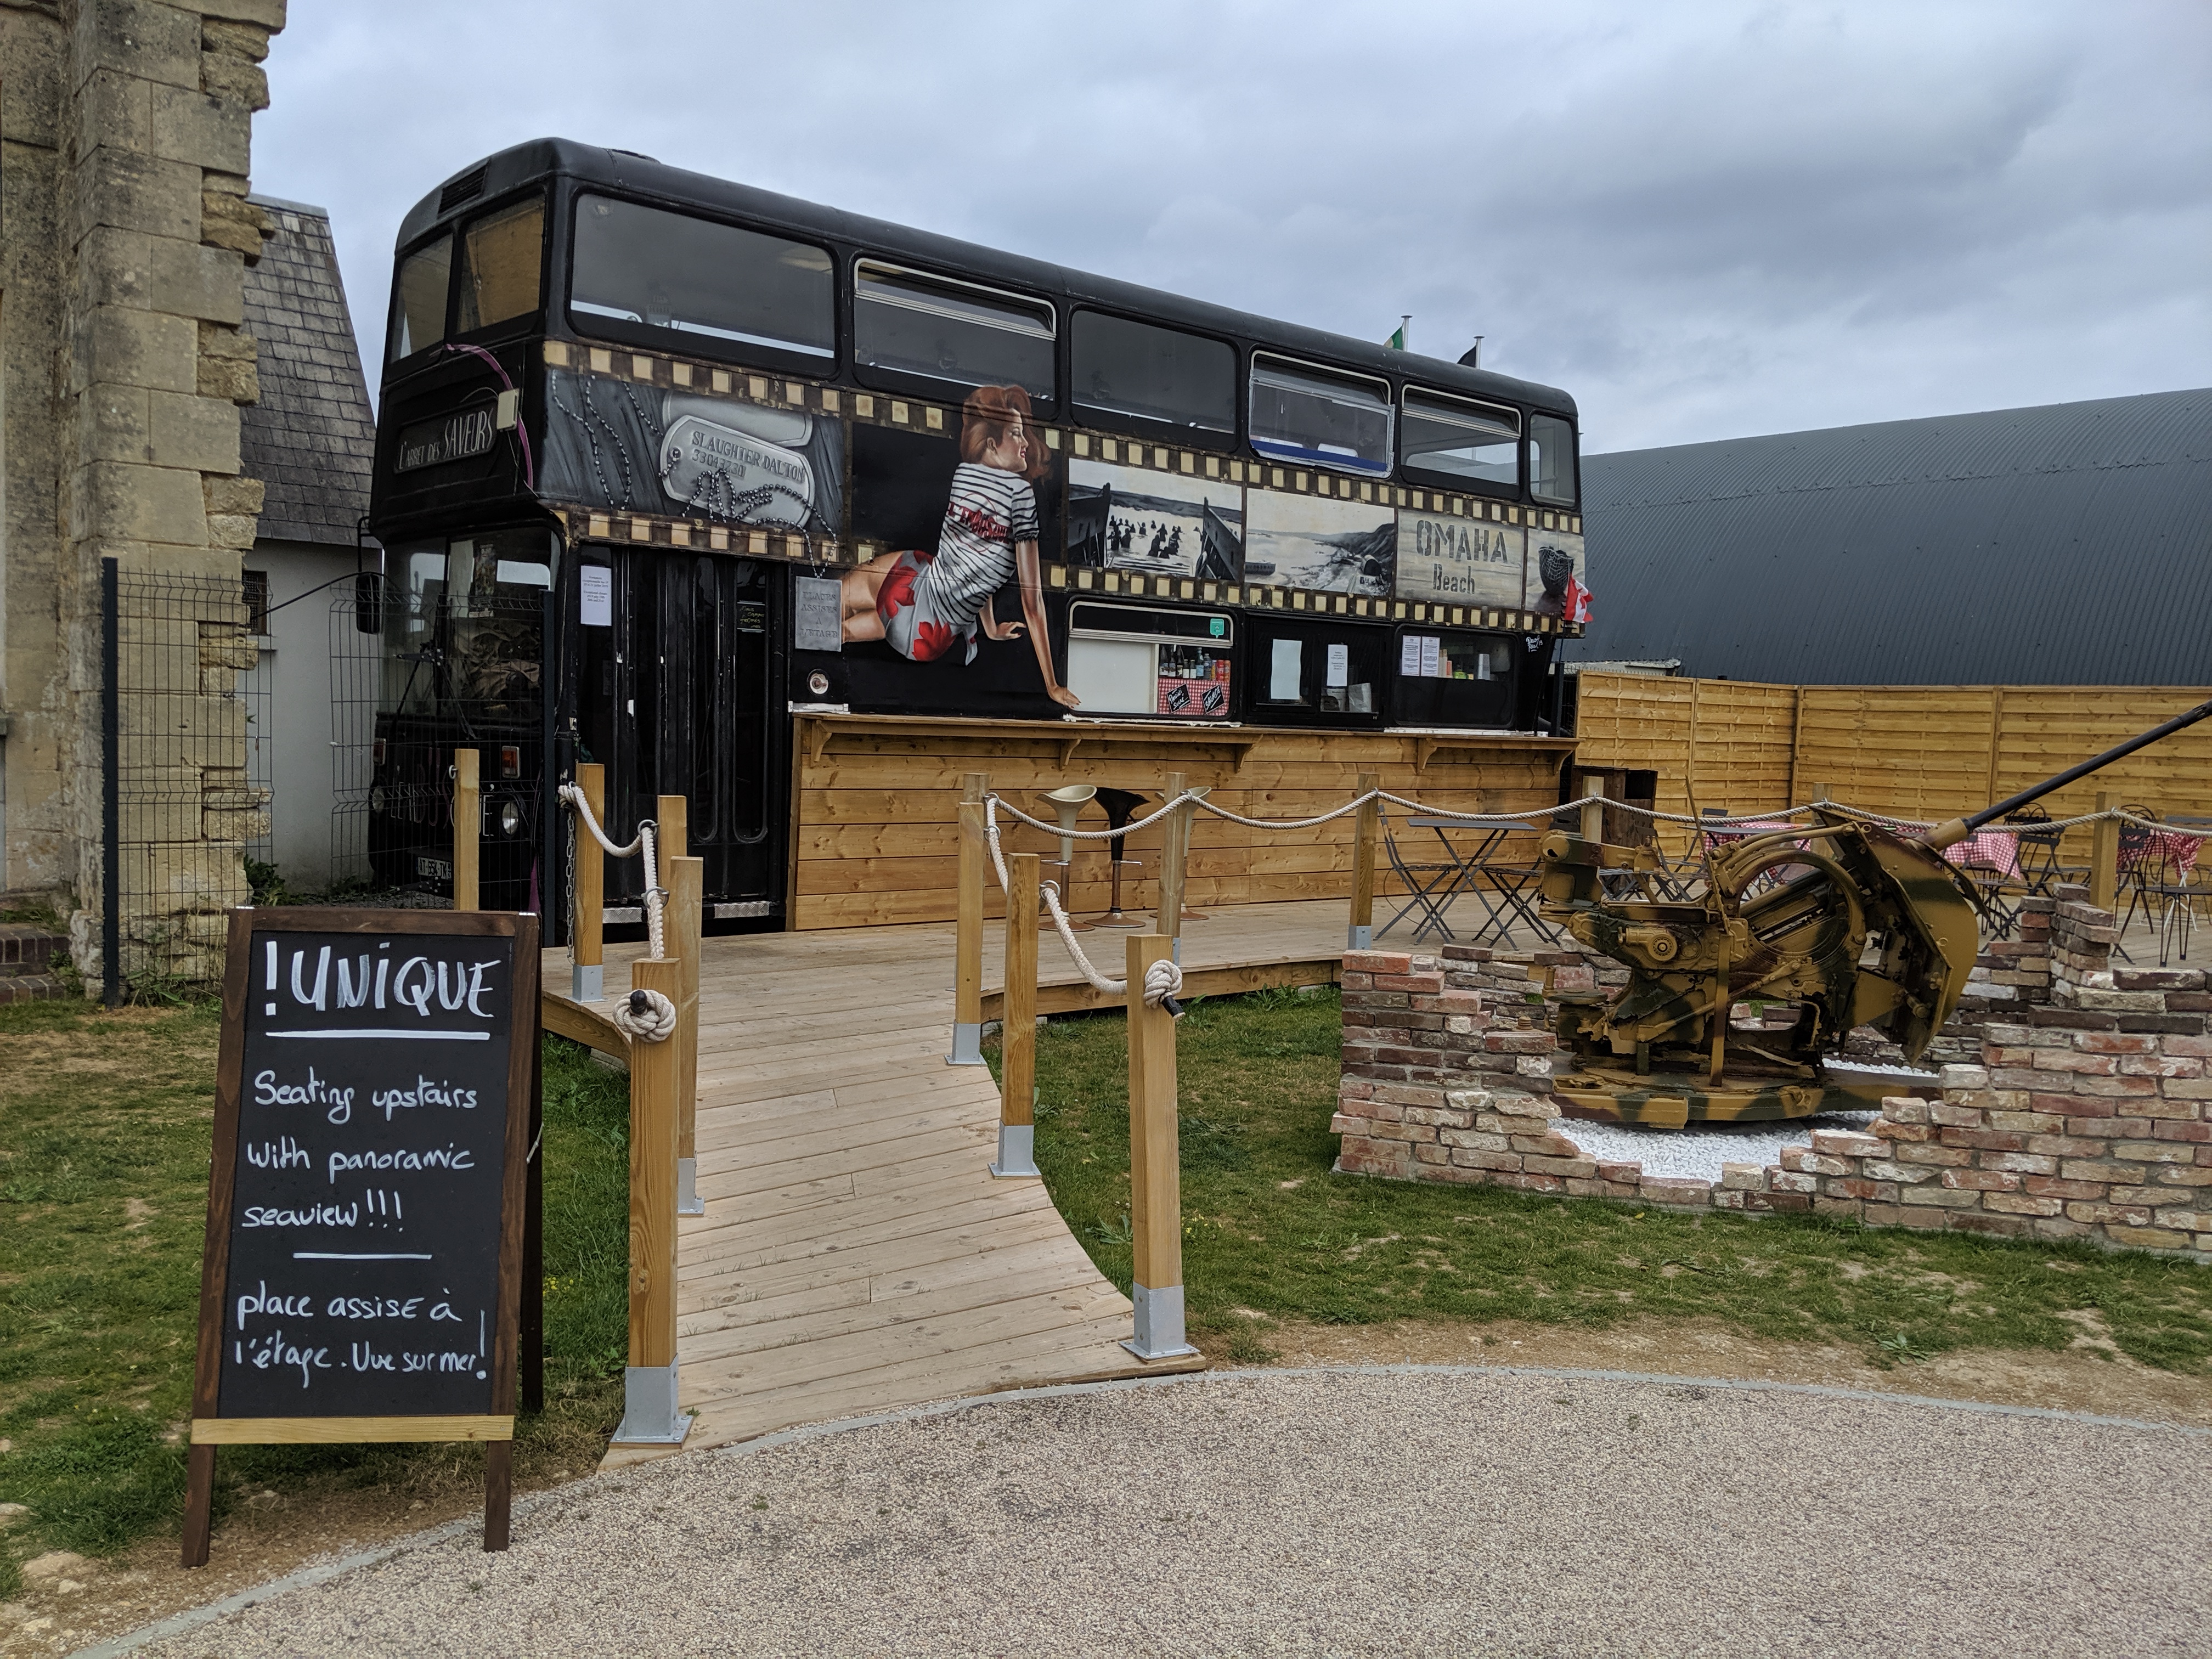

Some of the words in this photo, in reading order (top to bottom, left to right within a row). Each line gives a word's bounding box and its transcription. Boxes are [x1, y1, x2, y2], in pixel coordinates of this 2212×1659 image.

[443, 408, 493, 458] SAVEURS
[692, 431, 761, 467] SLAUGHTER
[763, 454, 805, 483] DALTON
[1416, 520, 1508, 563] OMAHA
[1432, 563, 1475, 594] Beach
[255, 1066, 354, 1125] Seating
[372, 1074, 477, 1121] upstairs
[329, 1142, 475, 1184] panoramic
[238, 1280, 314, 1330] place
[430, 1288, 462, 1322] à
[402, 1352, 436, 1372] sur
